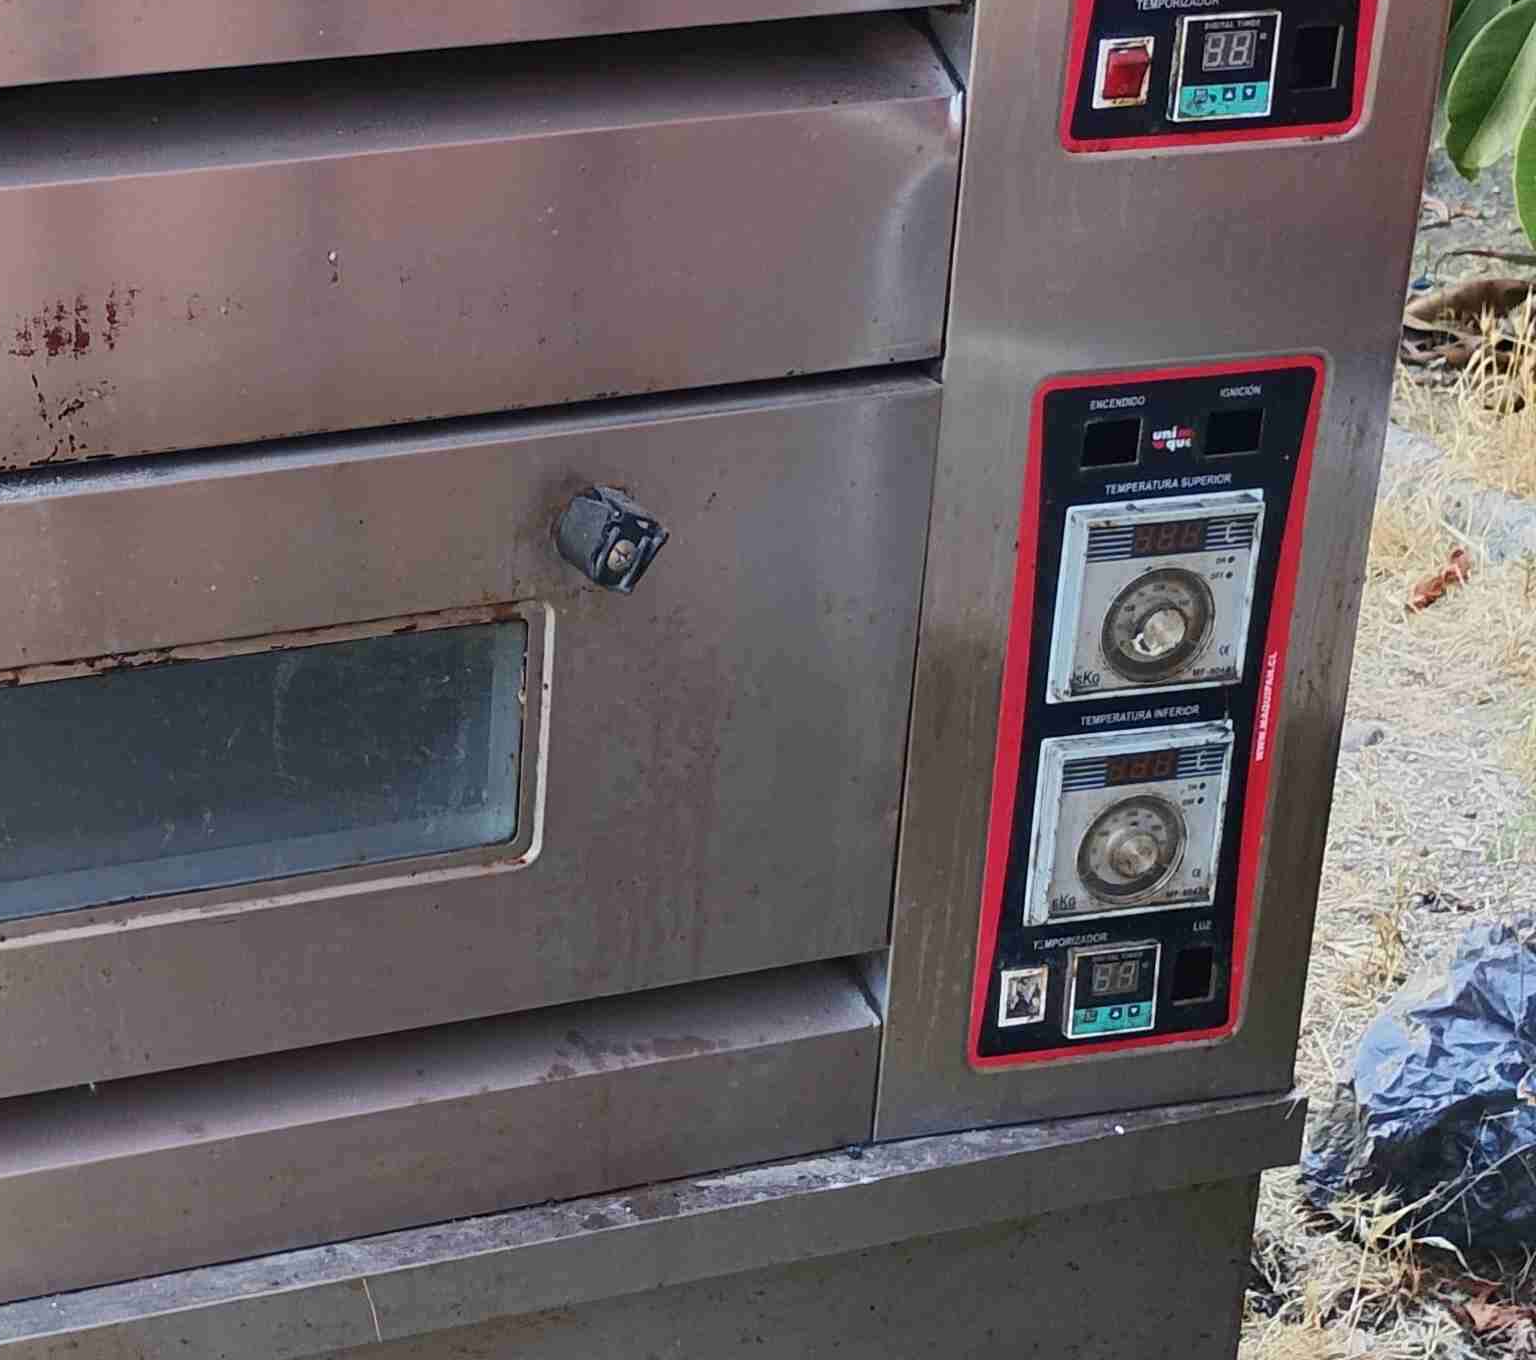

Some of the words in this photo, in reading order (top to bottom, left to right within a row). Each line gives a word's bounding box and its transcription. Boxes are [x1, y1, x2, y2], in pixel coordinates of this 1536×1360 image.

[1089, 395, 1146, 411] ENCENDIDO
[1105, 477, 1179, 495] TEMPERATURA
[1181, 472, 1232, 488] SUPERIOR
[1080, 708, 1152, 726] TEMPERATURA
[1153, 704, 1201, 720] INFERIOR
[1192, 919, 1212, 932] LUZ
